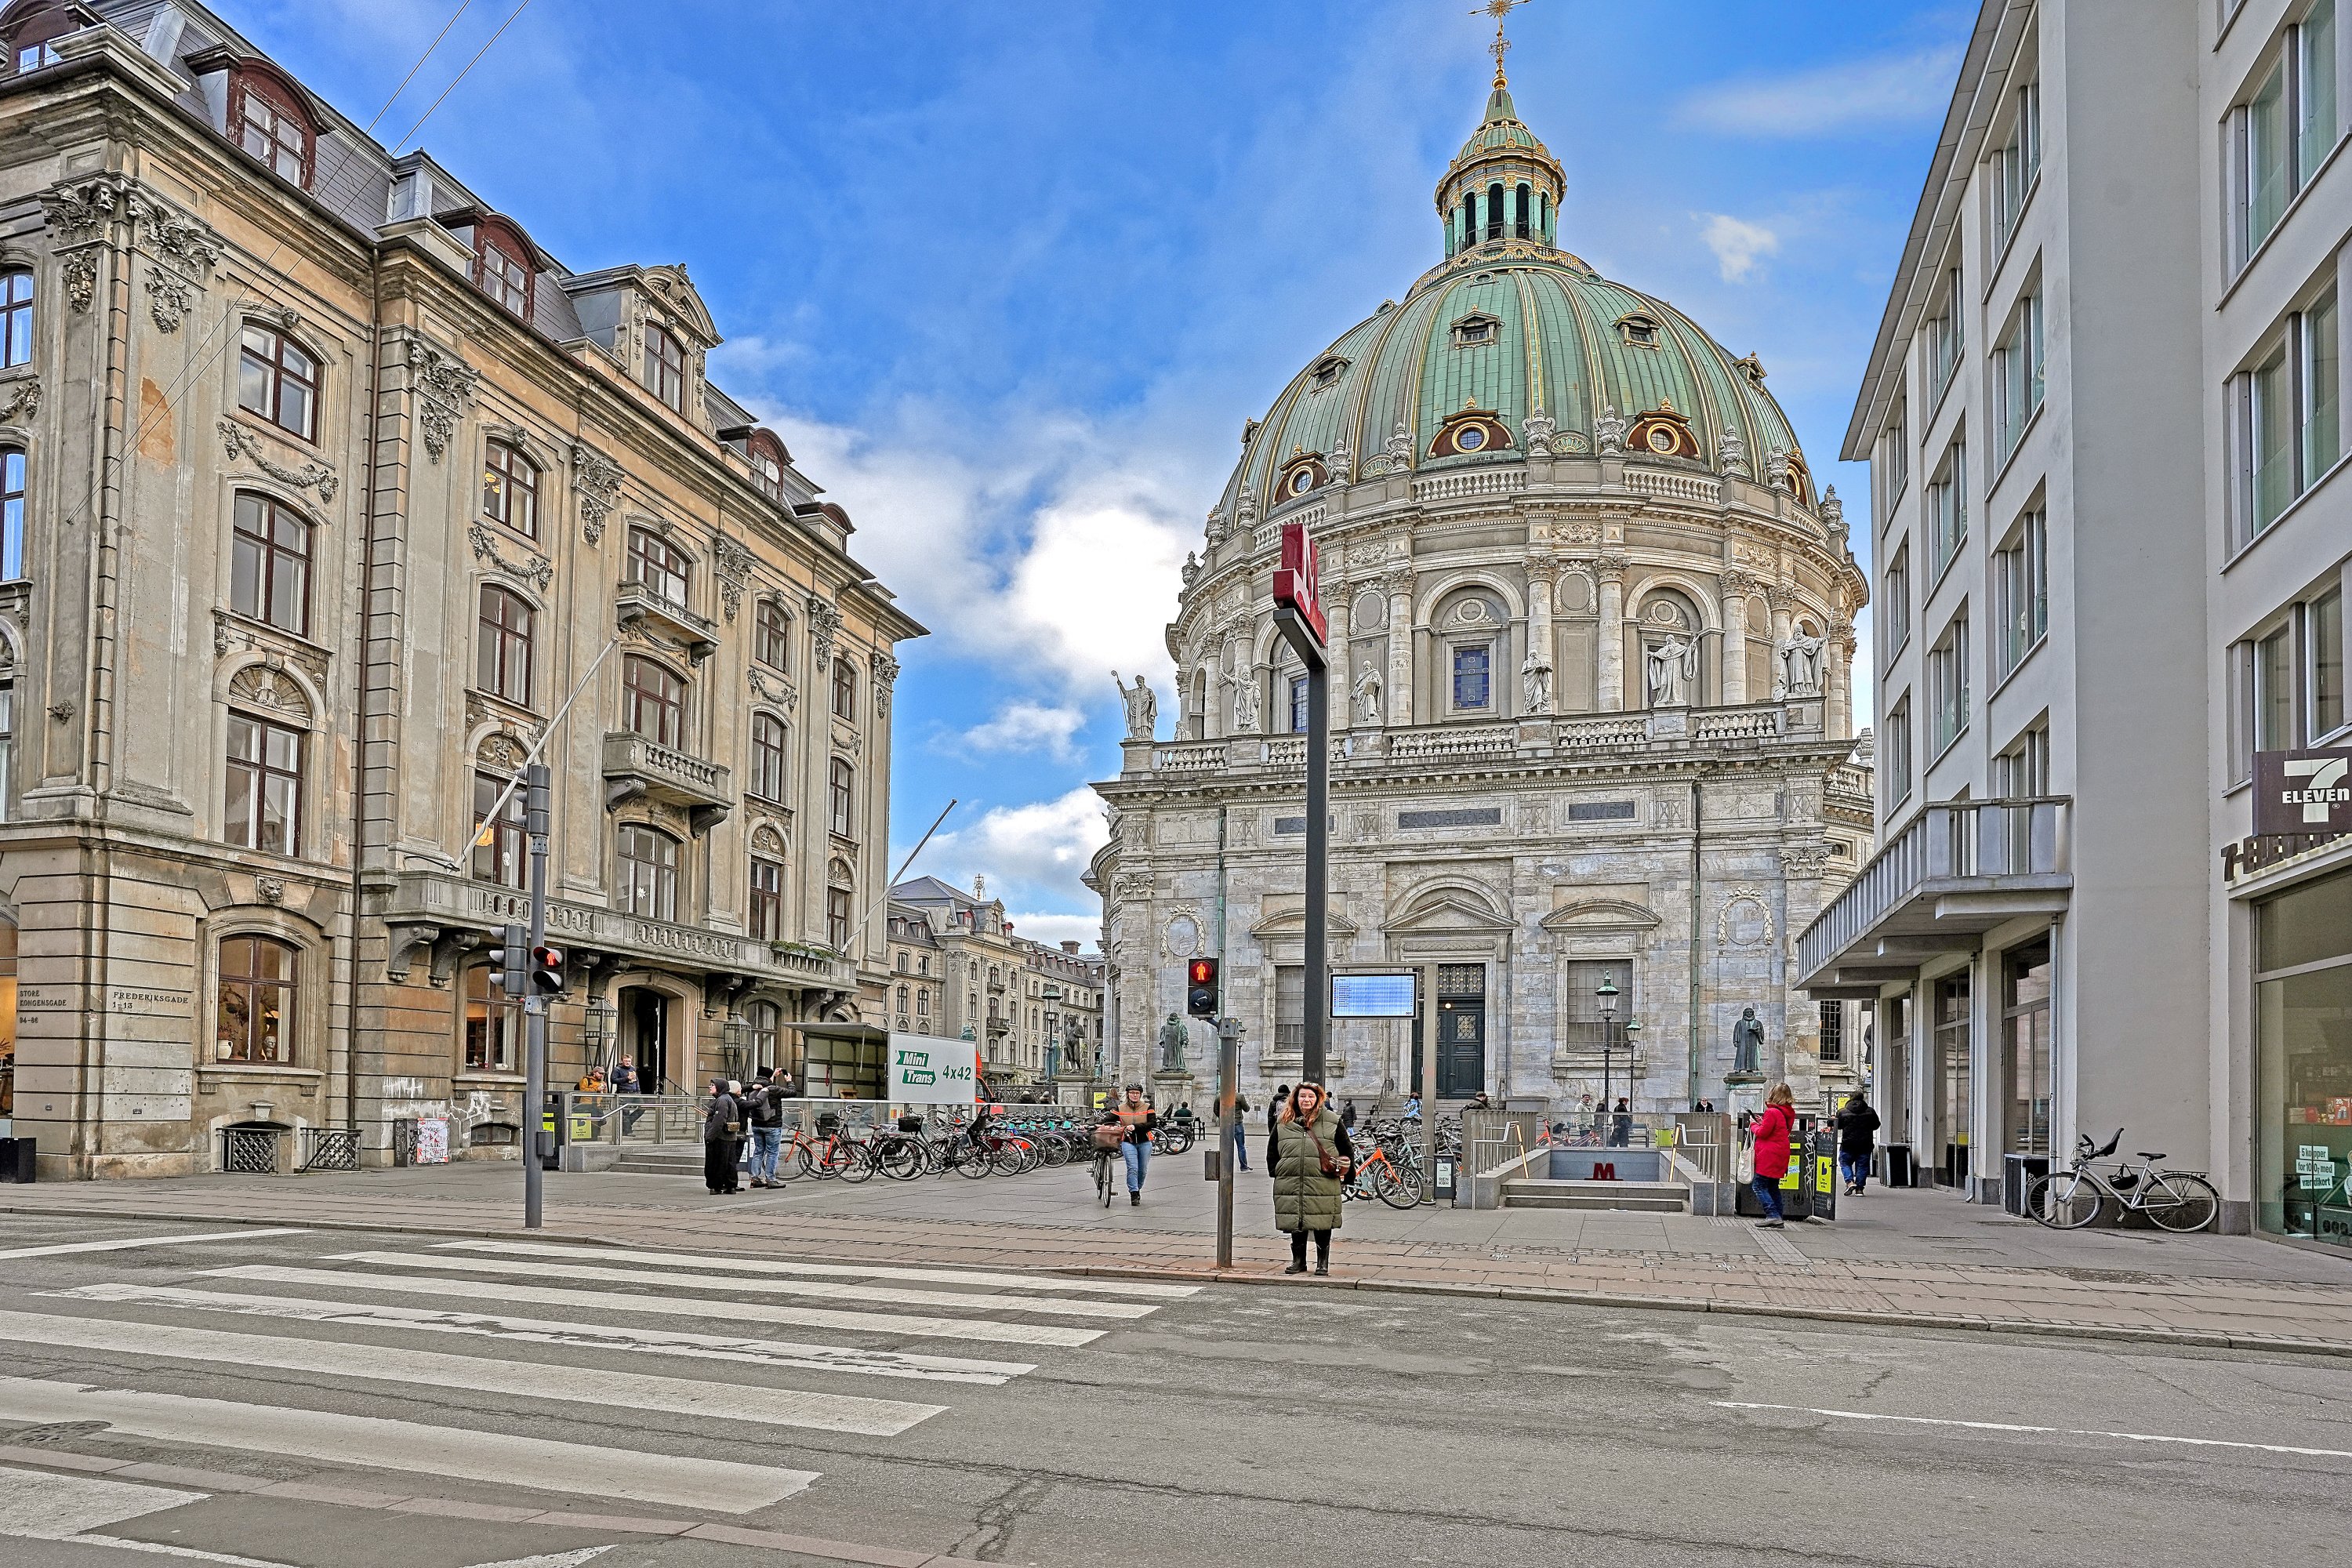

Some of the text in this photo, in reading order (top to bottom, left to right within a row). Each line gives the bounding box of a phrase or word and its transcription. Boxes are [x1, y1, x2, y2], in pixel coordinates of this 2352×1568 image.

[2284, 757, 2348, 823] 7
[1401, 811, 1497, 826] SANDHEDEN
[113, 991, 189, 1004] FREDERIKSGADE
[902, 1052, 927, 1066] Mini
[906, 1069, 934, 1083] Trans
[942, 1065, 971, 1081] 4x42
[2301, 1148, 2326, 1159] 5 kopper
[2320, 1164, 2333, 1174] med
[2302, 1177, 2331, 1187] værdikort
